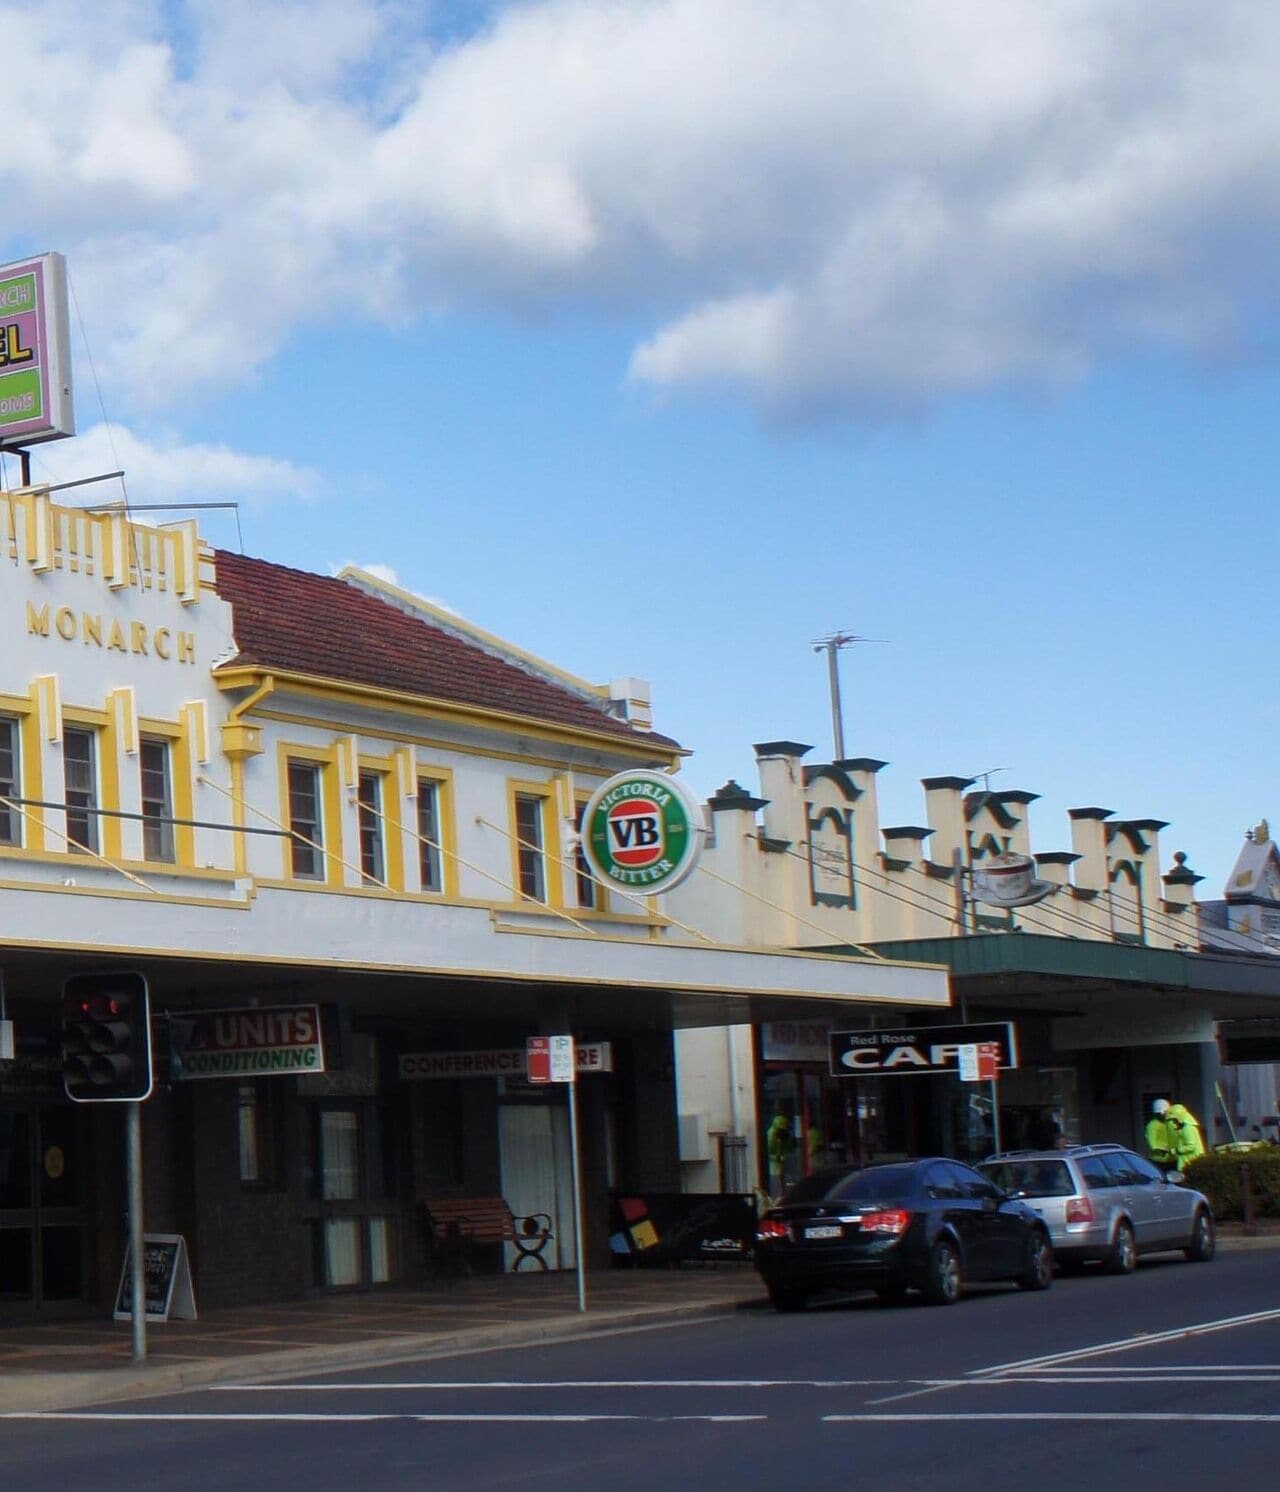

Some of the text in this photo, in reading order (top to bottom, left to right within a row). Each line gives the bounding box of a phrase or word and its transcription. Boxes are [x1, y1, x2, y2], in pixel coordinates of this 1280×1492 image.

[24, 599, 197, 665] MONARCH
[598, 783, 671, 811] VICTORIA
[608, 817, 659, 848] VB
[608, 859, 673, 882] BITTER
[215, 1010, 313, 1048] UNITS
[850, 1034, 916, 1046] Red Rose
[188, 1047, 316, 1073] CONDITIONING
[403, 1053, 521, 1073] CONFERENCE
[841, 1043, 996, 1069] CAF
